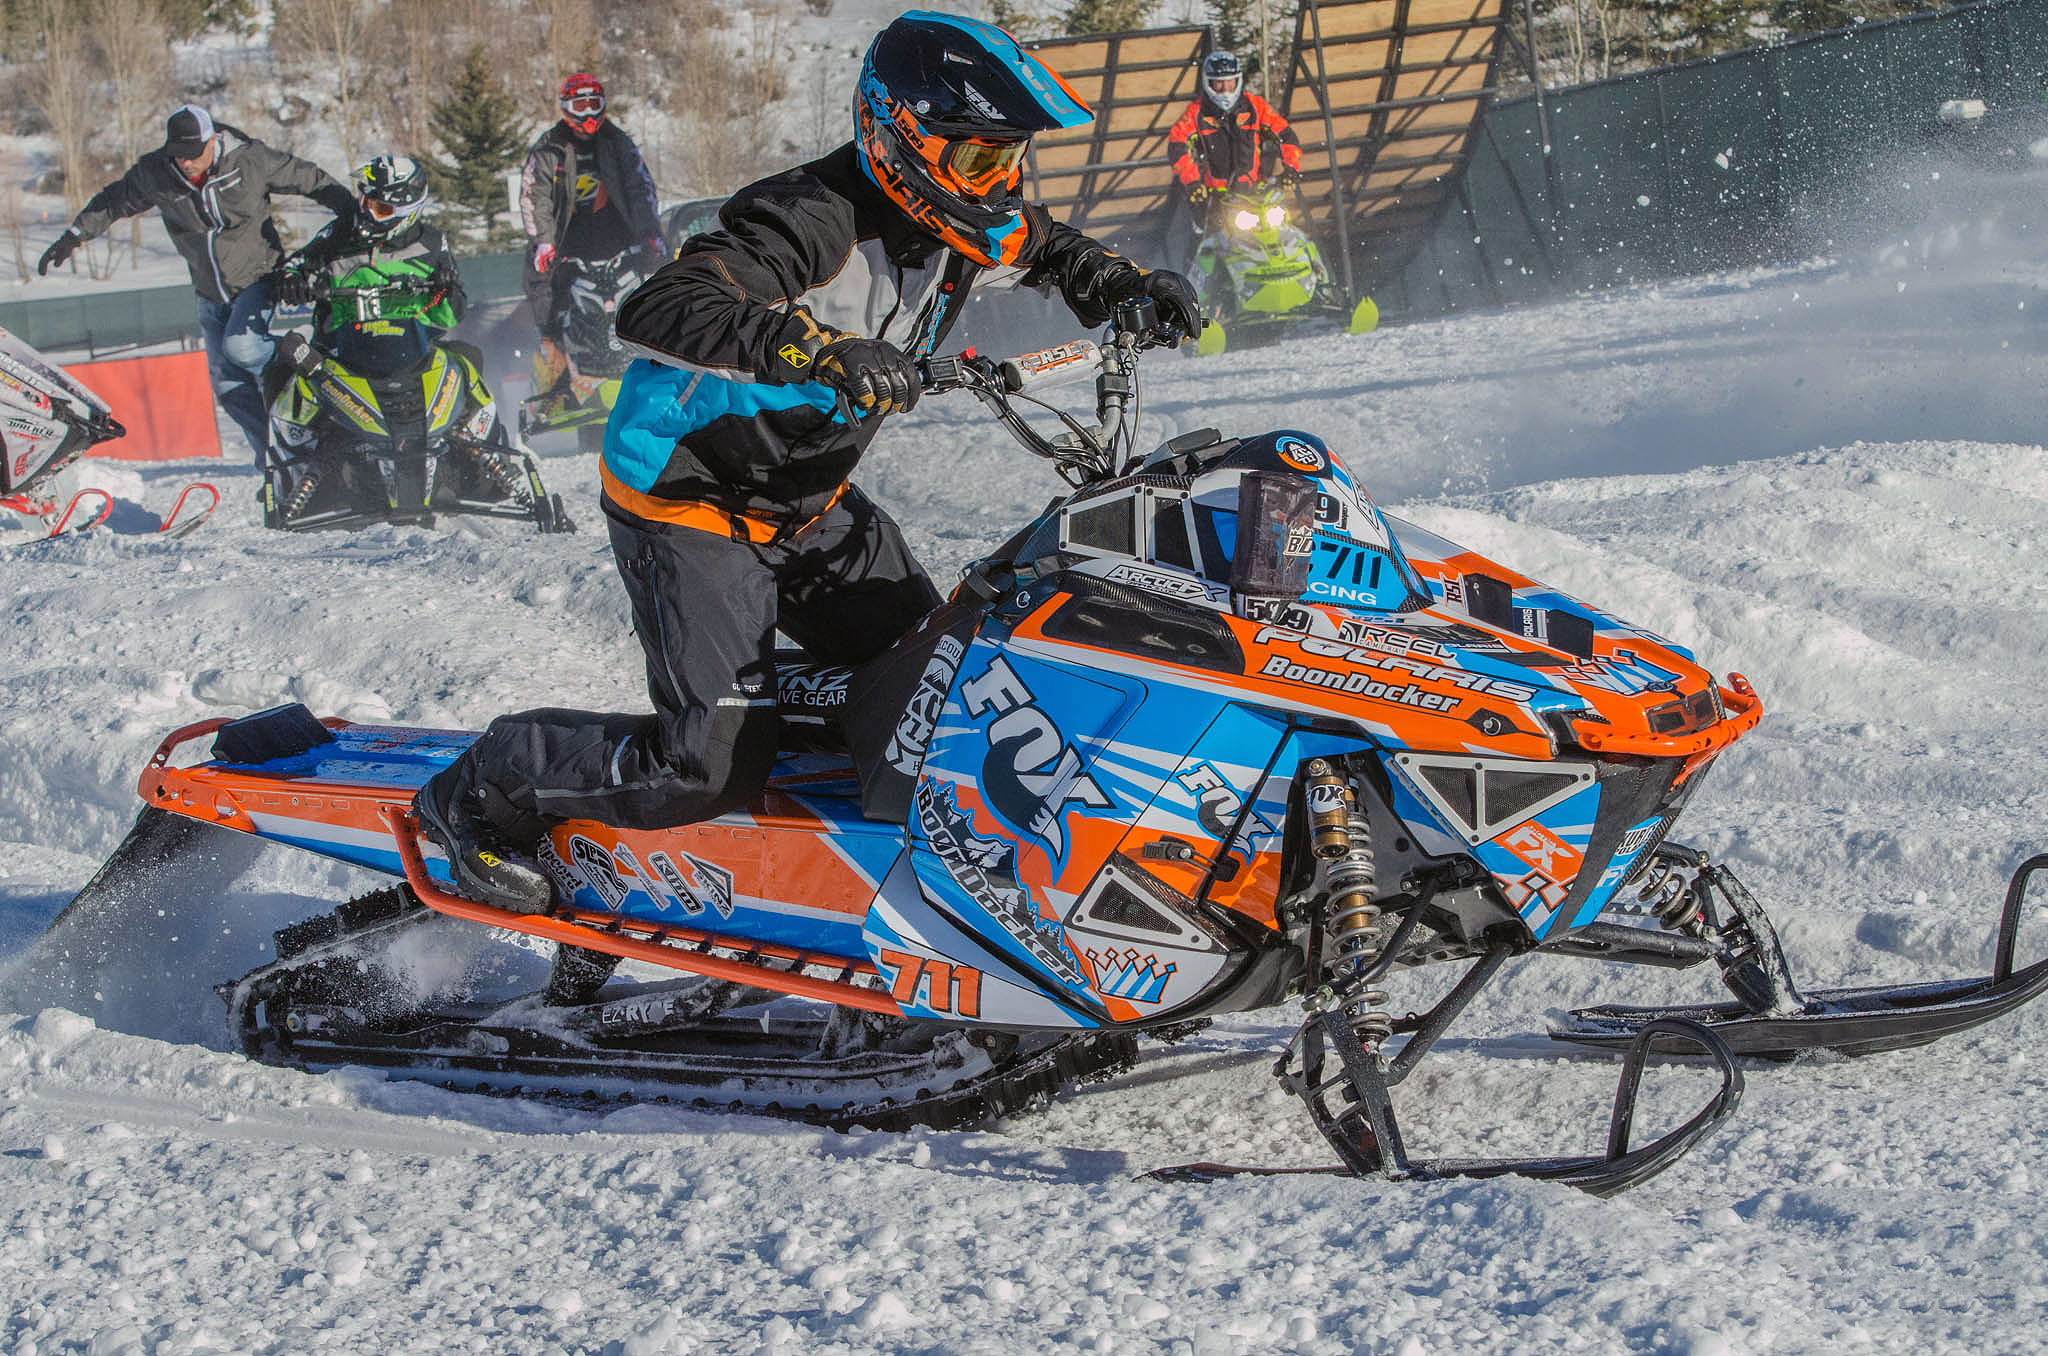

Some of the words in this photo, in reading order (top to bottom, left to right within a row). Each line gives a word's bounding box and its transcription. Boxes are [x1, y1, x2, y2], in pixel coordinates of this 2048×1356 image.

[898, 119, 925, 150] 509
[1307, 581, 1377, 606] CING
[1522, 608, 1534, 638] POLARIS
[776, 671, 854, 691] INZ
[1254, 625, 1537, 703] POLARIS
[1262, 655, 1462, 713] BoonDocker
[803, 690, 848, 706] GEAR
[959, 654, 1116, 850] FOX
[1177, 763, 1277, 852] FOX
[914, 783, 1086, 987] BoonDocker
[880, 949, 983, 1020] 711
